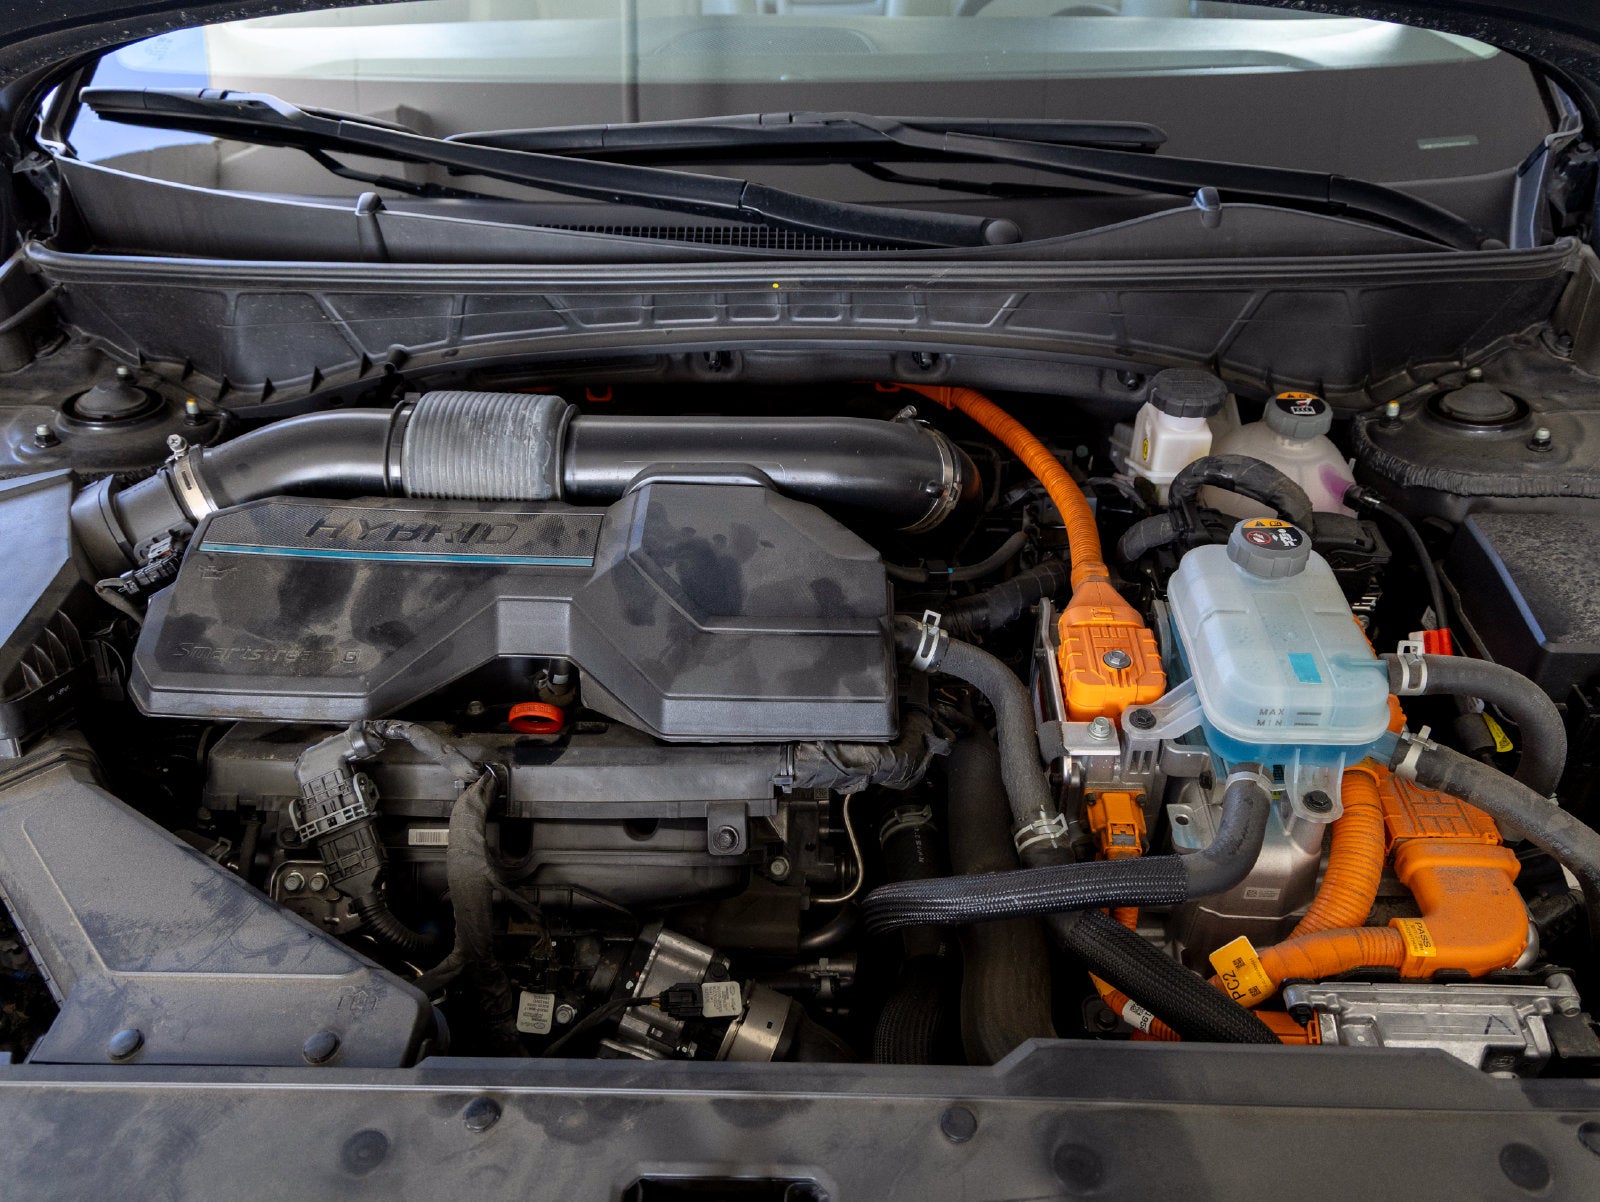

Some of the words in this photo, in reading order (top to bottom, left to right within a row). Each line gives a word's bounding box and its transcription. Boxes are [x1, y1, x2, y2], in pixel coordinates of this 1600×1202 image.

[304, 516, 519, 544] HYBRID
[1257, 719, 1283, 727] MIN
[1259, 708, 1285, 716] MAX
[1415, 921, 1431, 948] PASS
[1222, 970, 1246, 1000] PC2
